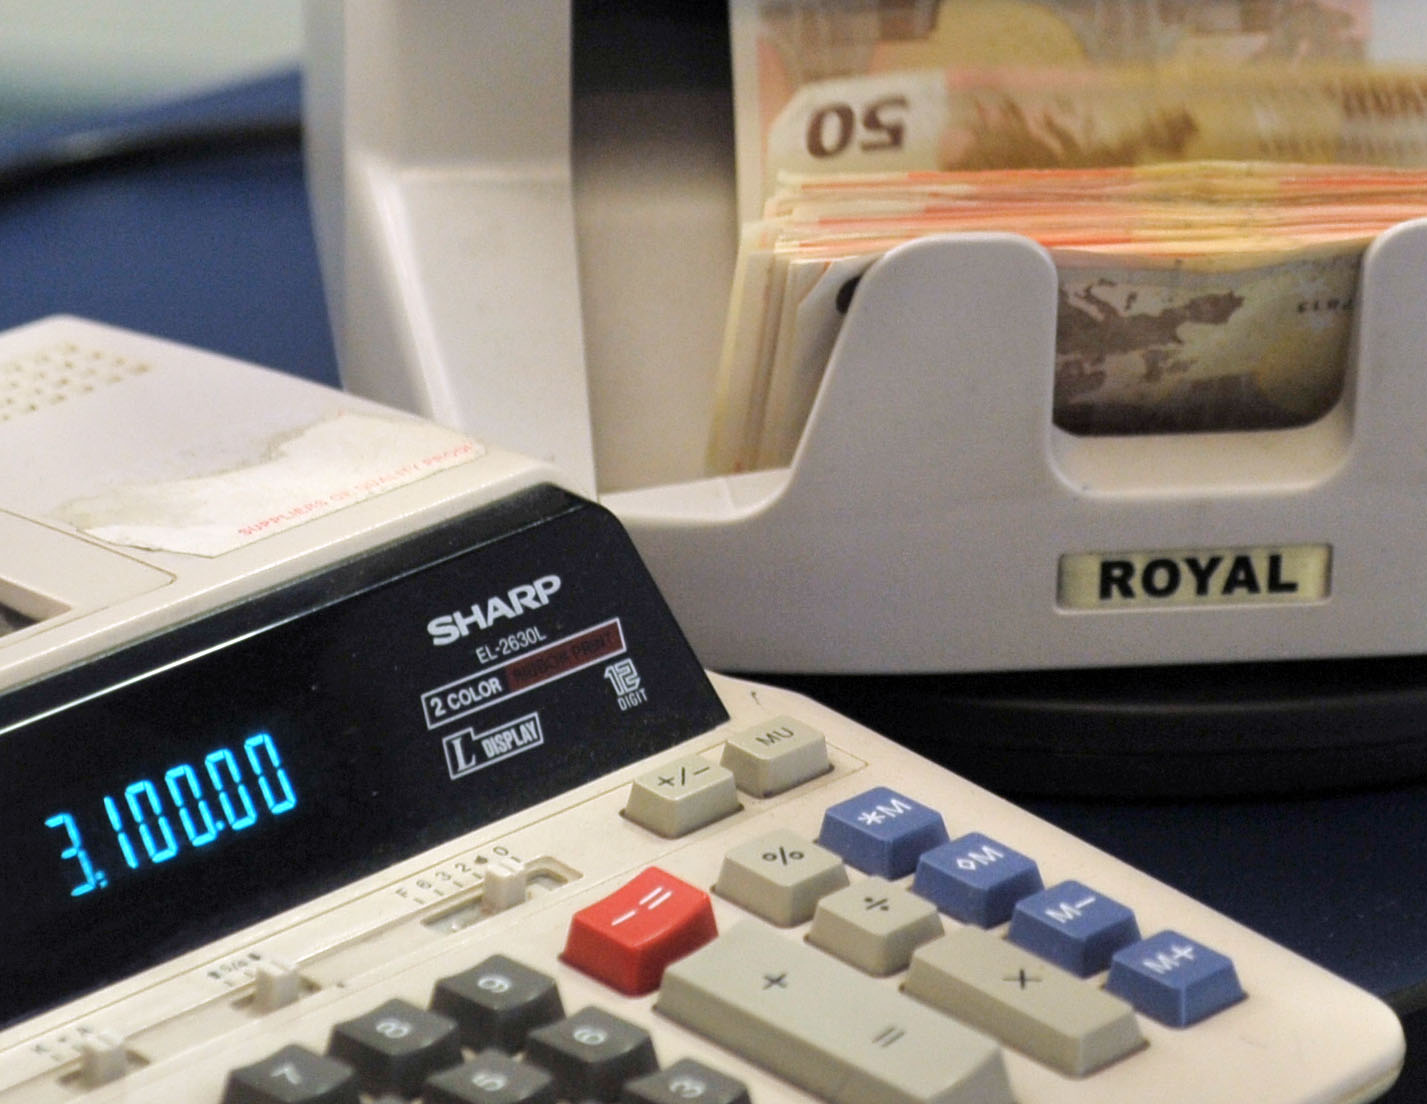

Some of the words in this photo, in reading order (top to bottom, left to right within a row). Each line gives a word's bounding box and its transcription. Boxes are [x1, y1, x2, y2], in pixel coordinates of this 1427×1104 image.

[806, 94, 910, 161] 50
[1098, 553, 1299, 600] ROYAL
[427, 574, 562, 646] SHARP
[475, 626, 547, 665] EL-2630L
[603, 657, 642, 697] 12
[430, 698, 446, 718] 2
[446, 677, 503, 711] COLOR
[617, 689, 648, 712] DIGIT
[451, 737, 477, 773] L
[480, 719, 540, 760] DISPLAY
[754, 725, 796, 748] MU
[1143, 944, 1196, 975] M+
[271, 1064, 302, 1086] 7
